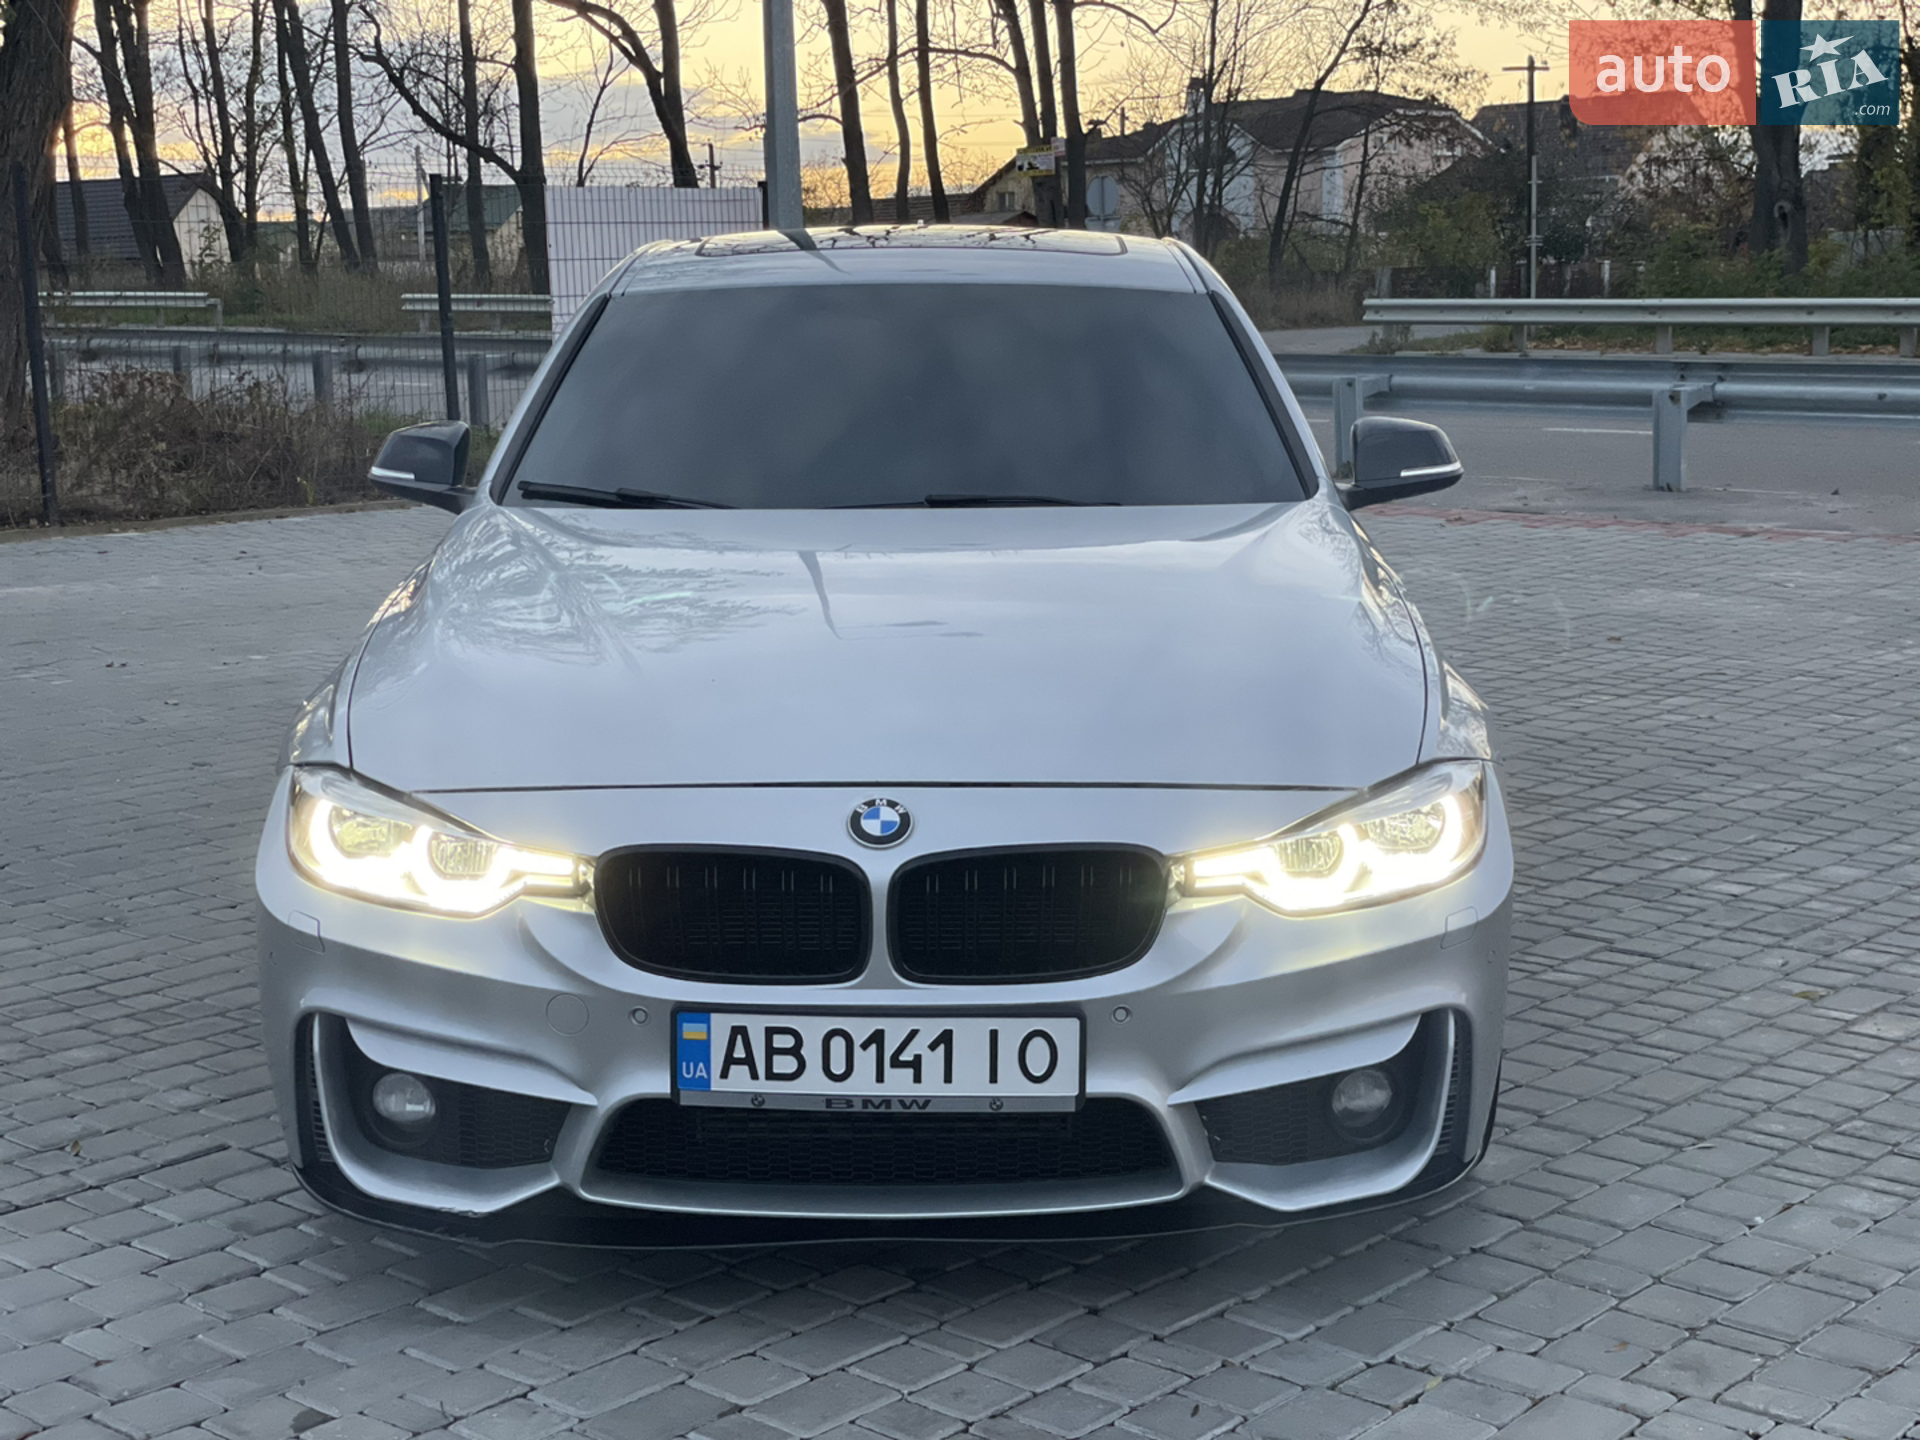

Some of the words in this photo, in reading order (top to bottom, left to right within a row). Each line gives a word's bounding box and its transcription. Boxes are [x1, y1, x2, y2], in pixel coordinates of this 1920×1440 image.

[855, 799, 907, 814] BMW
[719, 1025, 807, 1082] AB
[820, 1027, 954, 1084] 0141
[989, 1028, 1059, 1084] IO
[682, 1061, 708, 1079] UA
[825, 1098, 932, 1110] BMW
